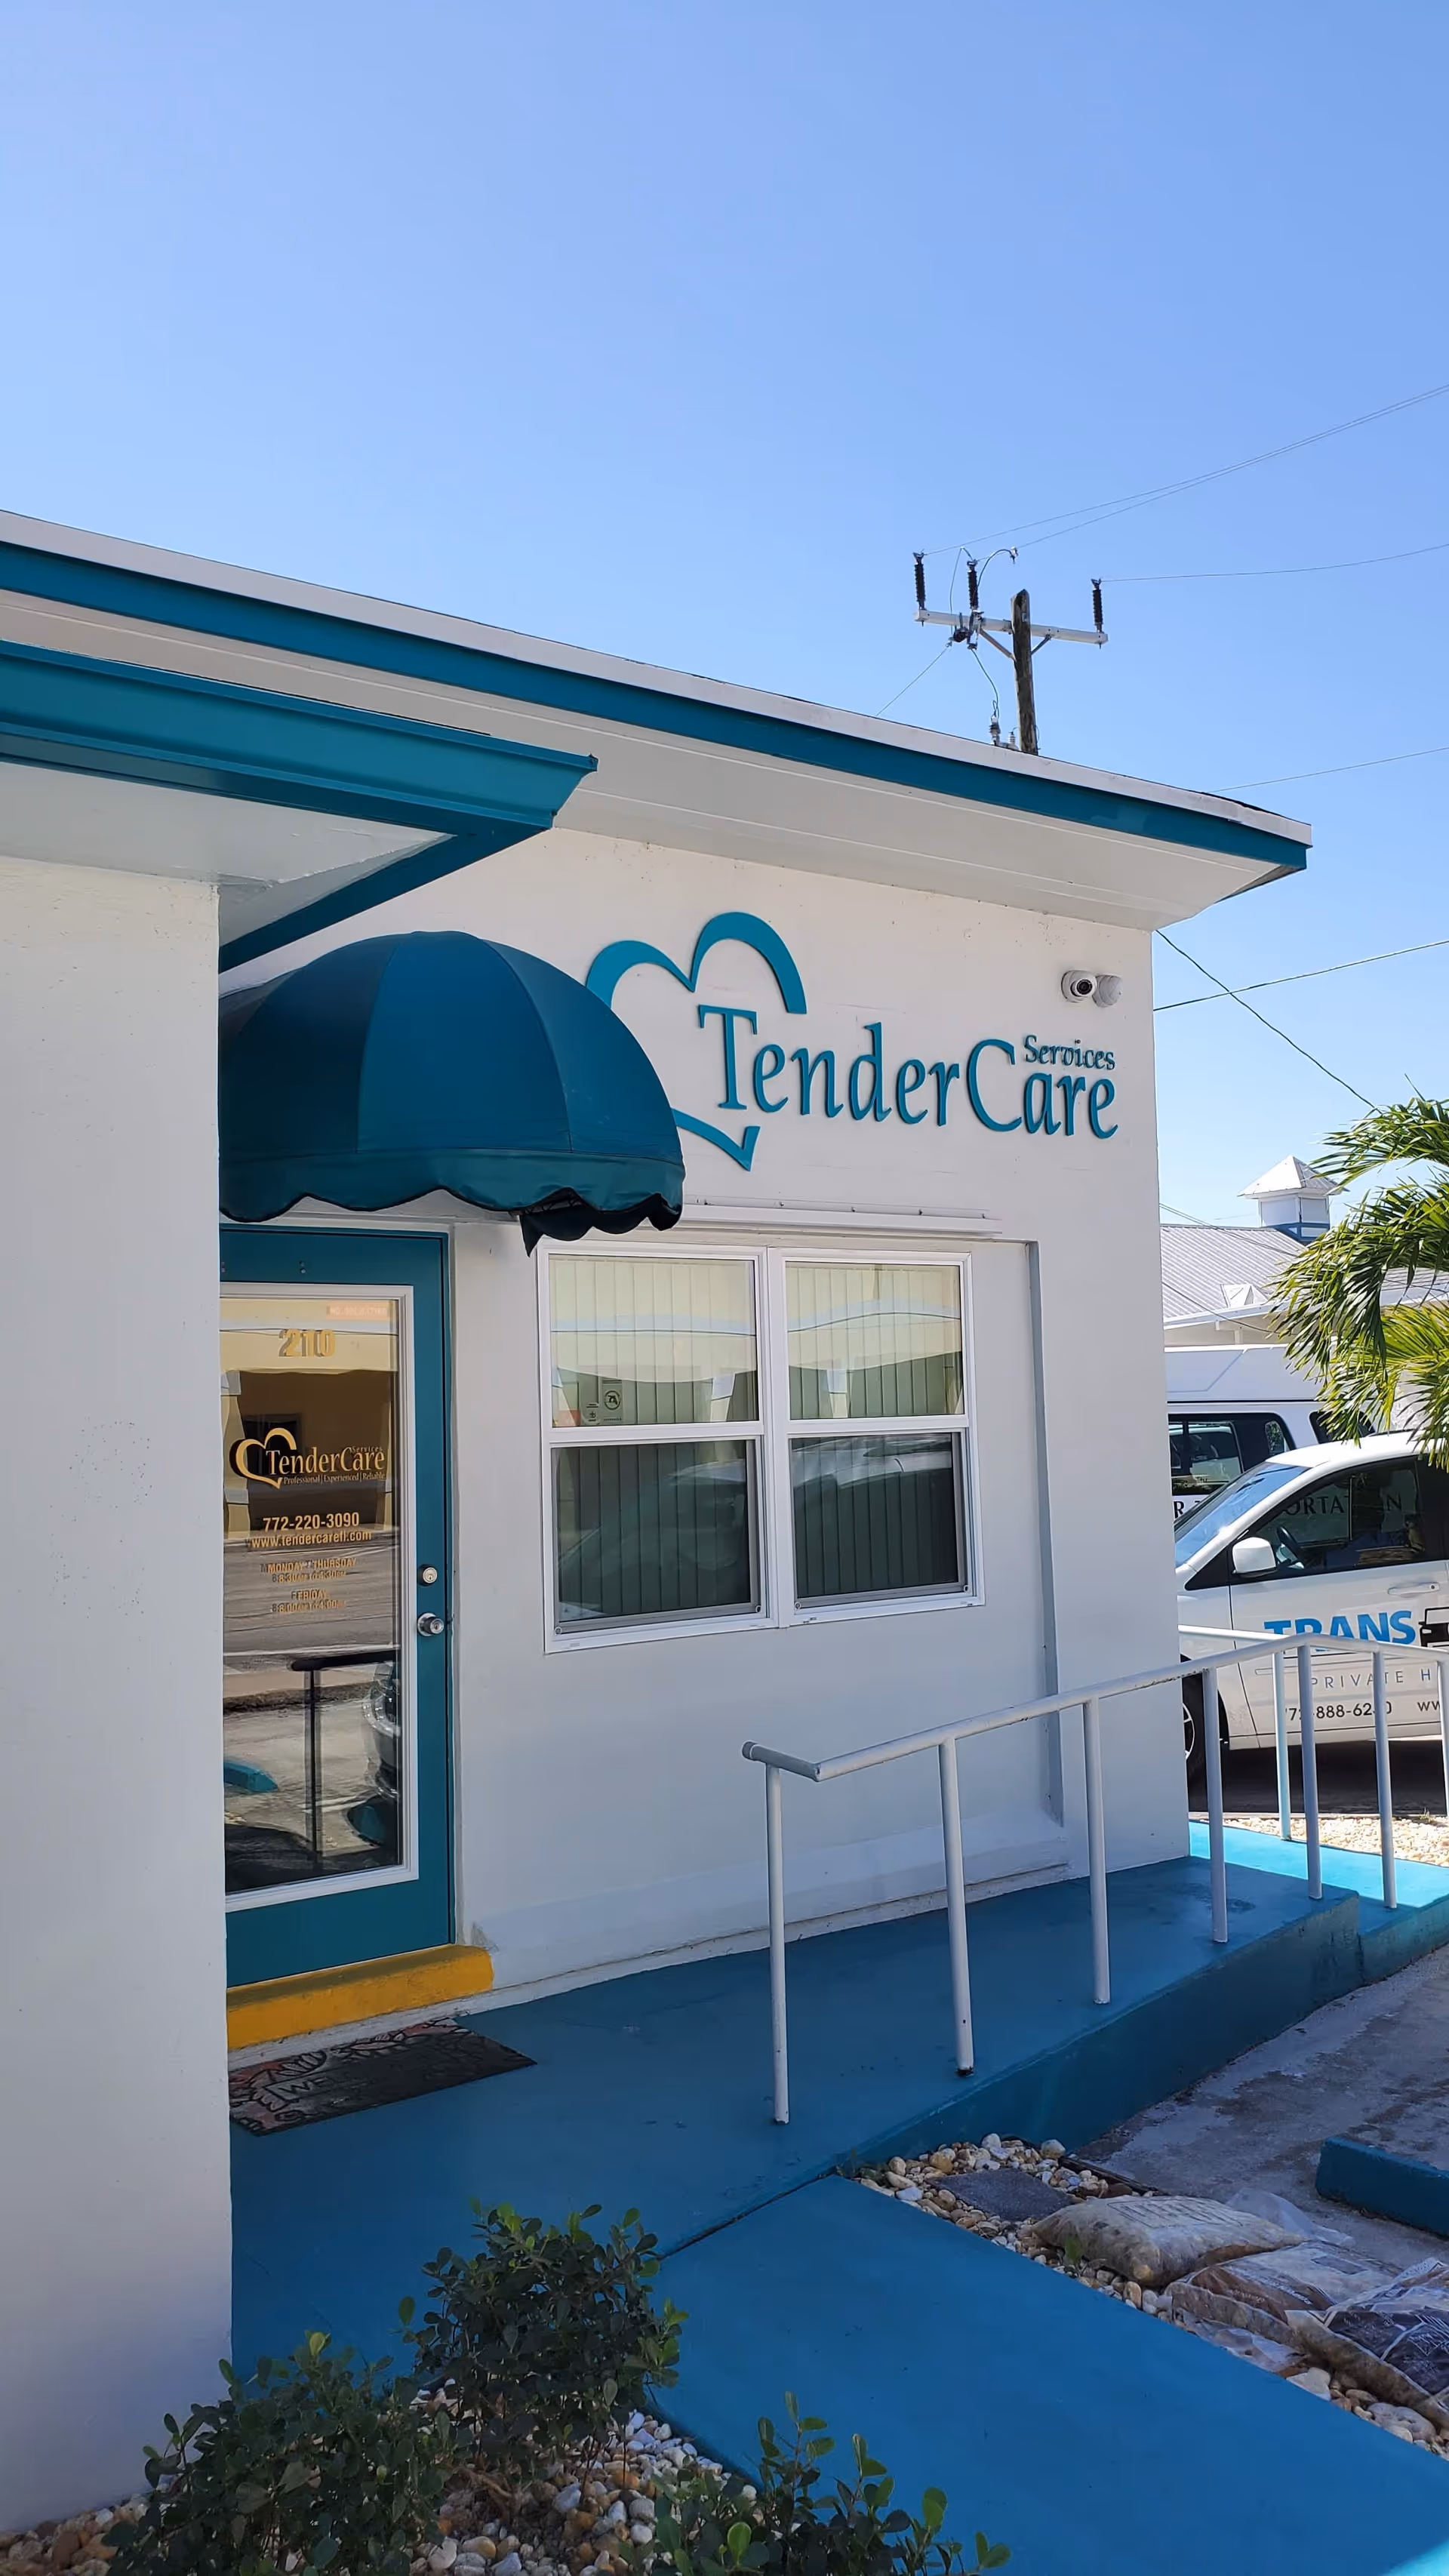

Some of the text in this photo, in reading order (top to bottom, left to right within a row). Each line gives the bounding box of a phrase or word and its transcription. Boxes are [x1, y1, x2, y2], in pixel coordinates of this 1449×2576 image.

[1024, 1035, 1116, 1071] Services
[698, 1004, 1118, 1139] TenderCare
[285, 1329, 334, 1356] 210
[266, 1447, 385, 1475] TenderCare
[324, 1473, 359, 1483] Experienced
[362, 1471, 386, 1480] Reliable
[263, 1512, 360, 1532] 772-220-3090
[251, 1530, 372, 1548] www.tendercarefl.com
